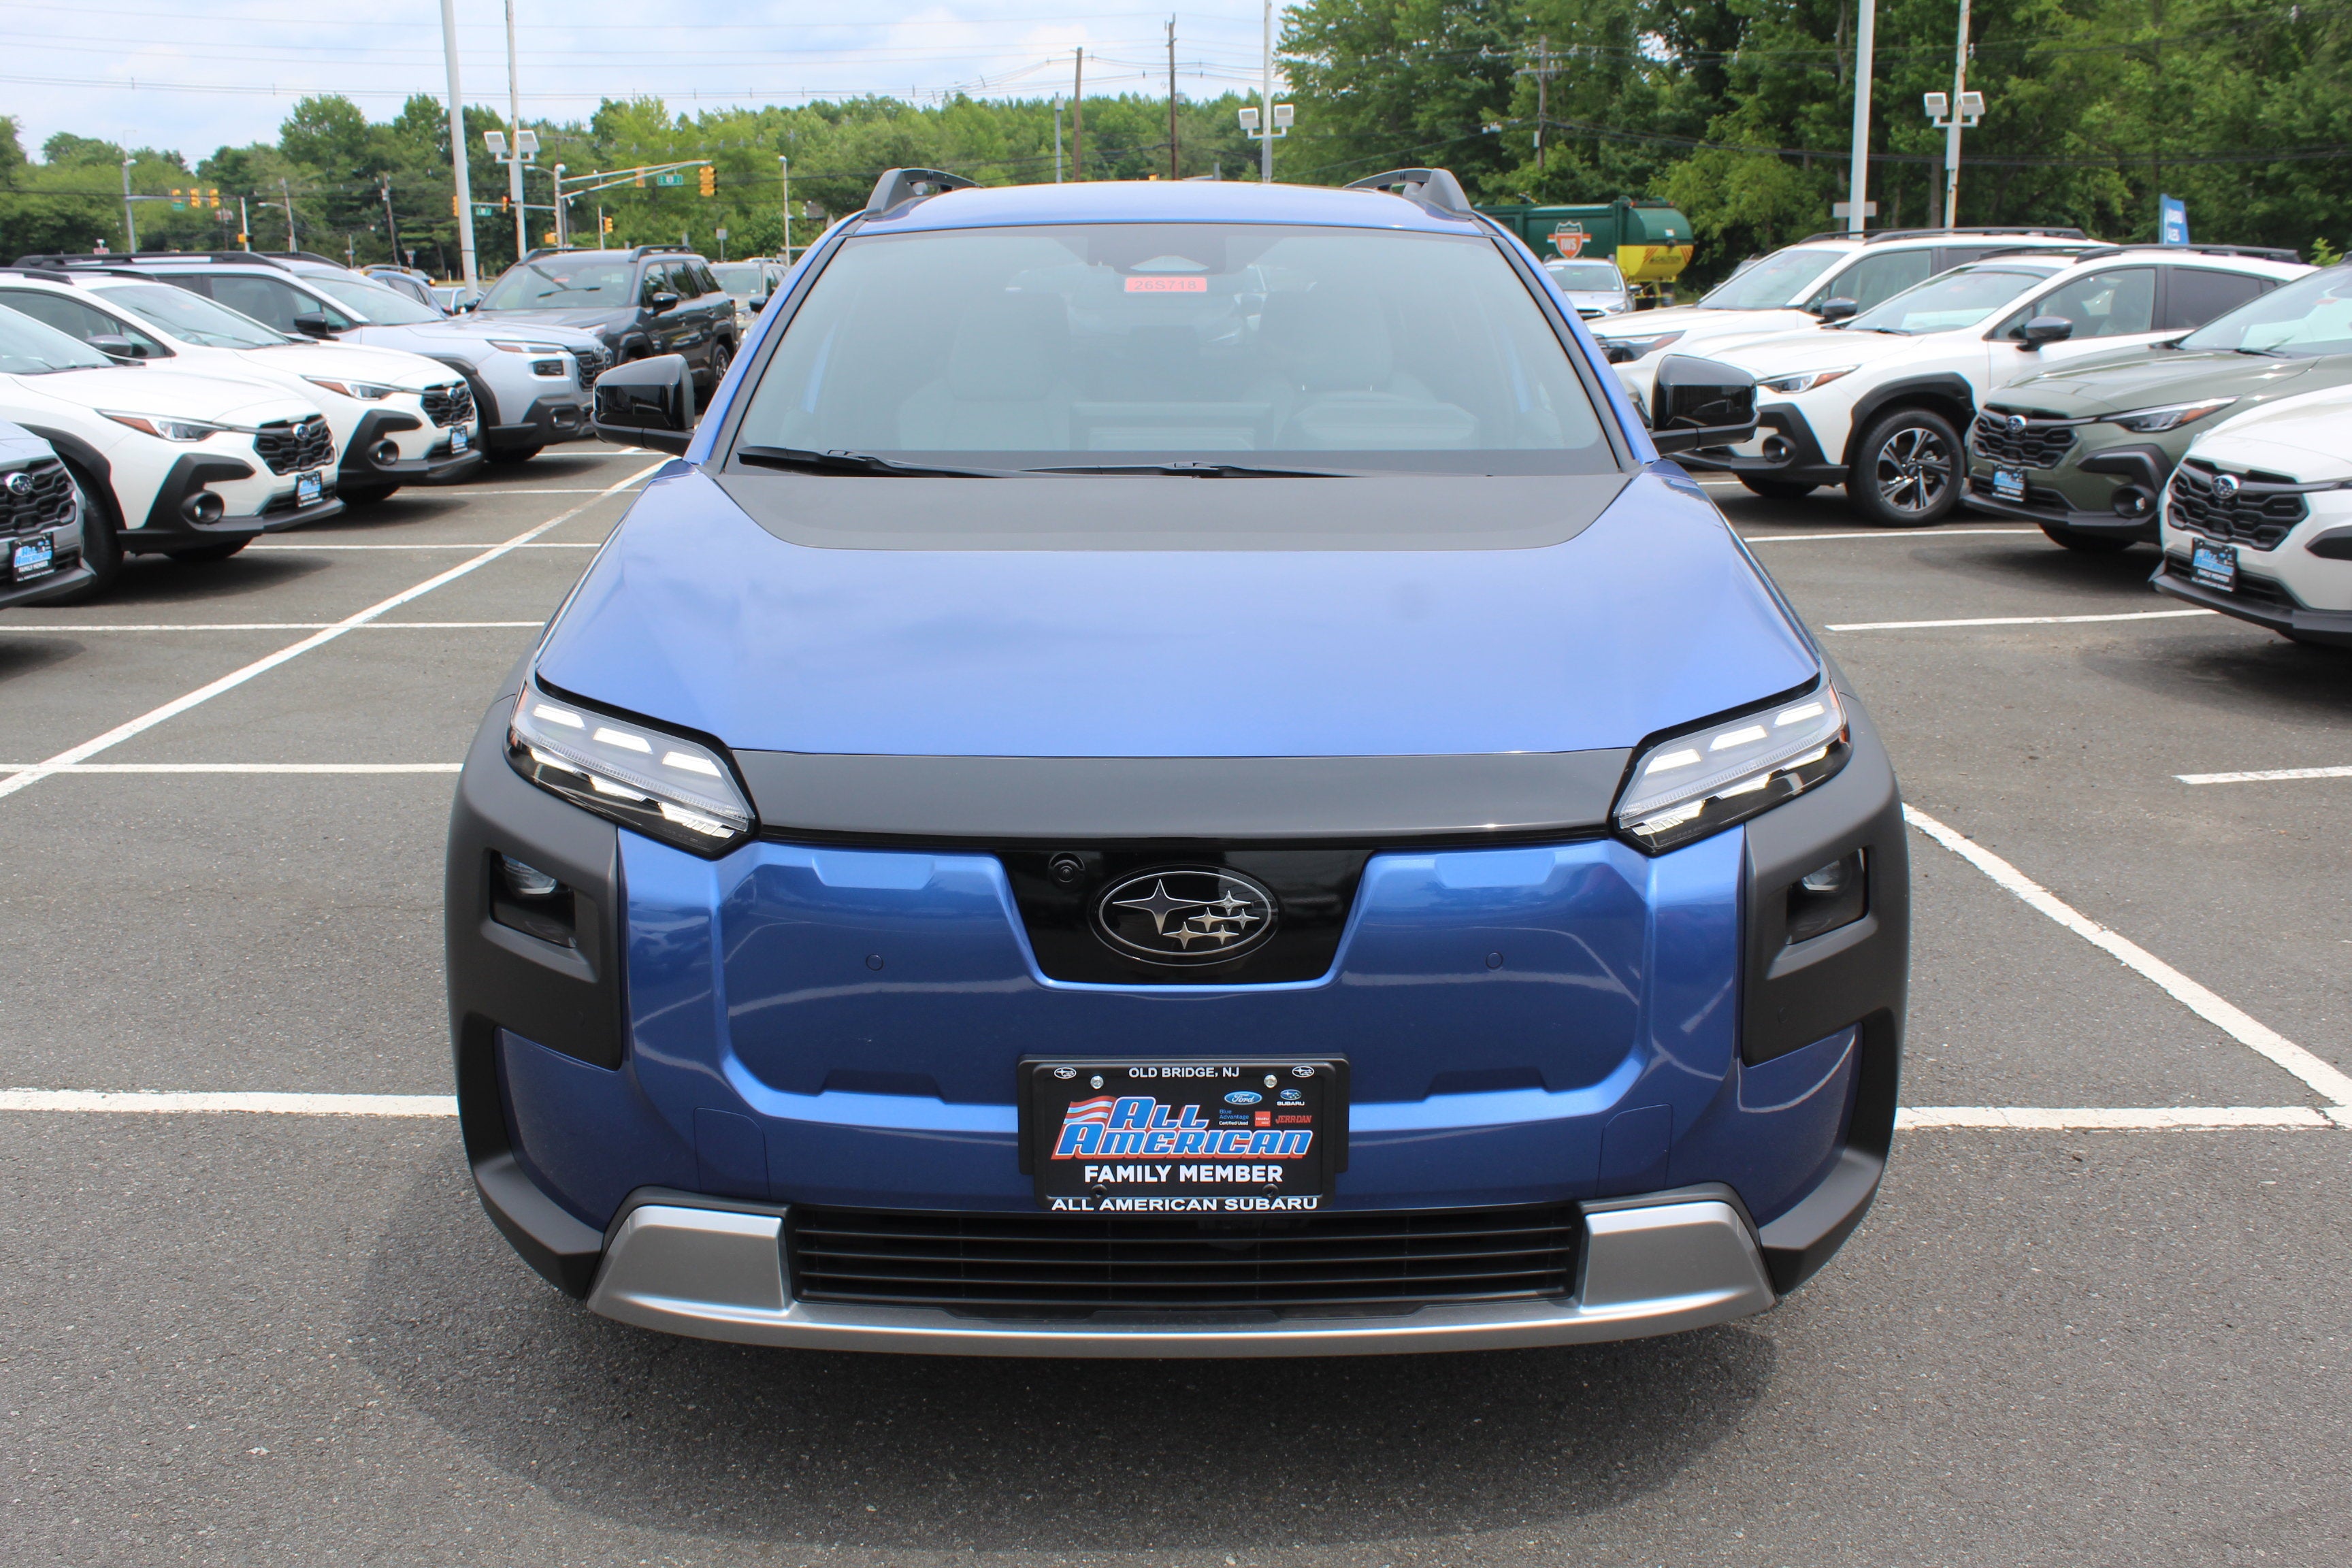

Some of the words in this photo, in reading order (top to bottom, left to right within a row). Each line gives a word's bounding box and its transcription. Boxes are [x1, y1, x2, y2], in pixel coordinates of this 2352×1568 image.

[1134, 280, 1196, 291] 26S718
[1128, 1067, 1159, 1078] OLD
[1161, 1067, 1219, 1079] BRIDGE,
[1222, 1066, 1239, 1078] NJ
[1231, 1093, 1254, 1102] Ford
[1084, 1165, 1171, 1183] FAMILY
[1179, 1165, 1284, 1183] MEMBER
[1051, 1198, 1094, 1211] ALL
[1099, 1198, 1218, 1211] AMERICAN
[1224, 1197, 1318, 1211] SUBARU
